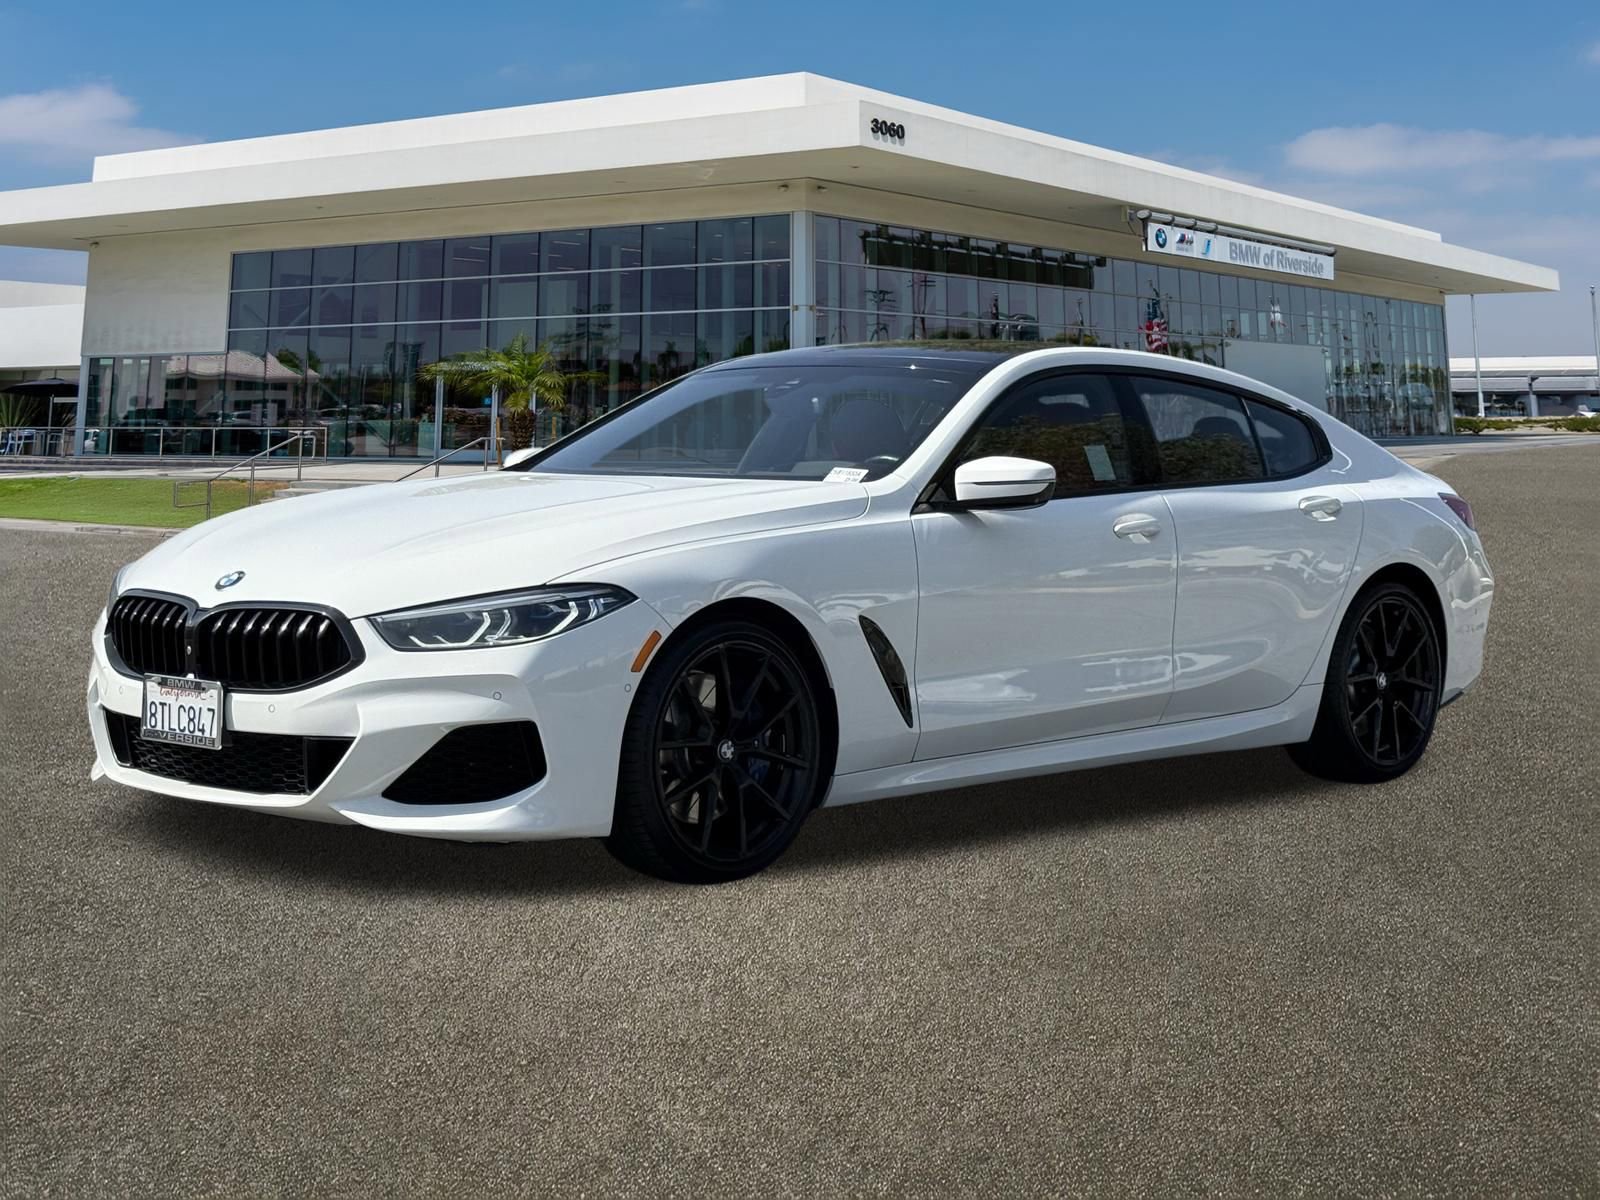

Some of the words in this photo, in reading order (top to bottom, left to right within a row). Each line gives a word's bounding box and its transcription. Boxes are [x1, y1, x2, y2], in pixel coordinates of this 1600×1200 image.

[871, 117, 905, 140] 3060
[1229, 241, 1261, 265] BMW
[1263, 251, 1274, 268] of
[1276, 252, 1325, 276] Riverside
[167, 678, 196, 689] BMW
[149, 700, 215, 737] 8TLC847
